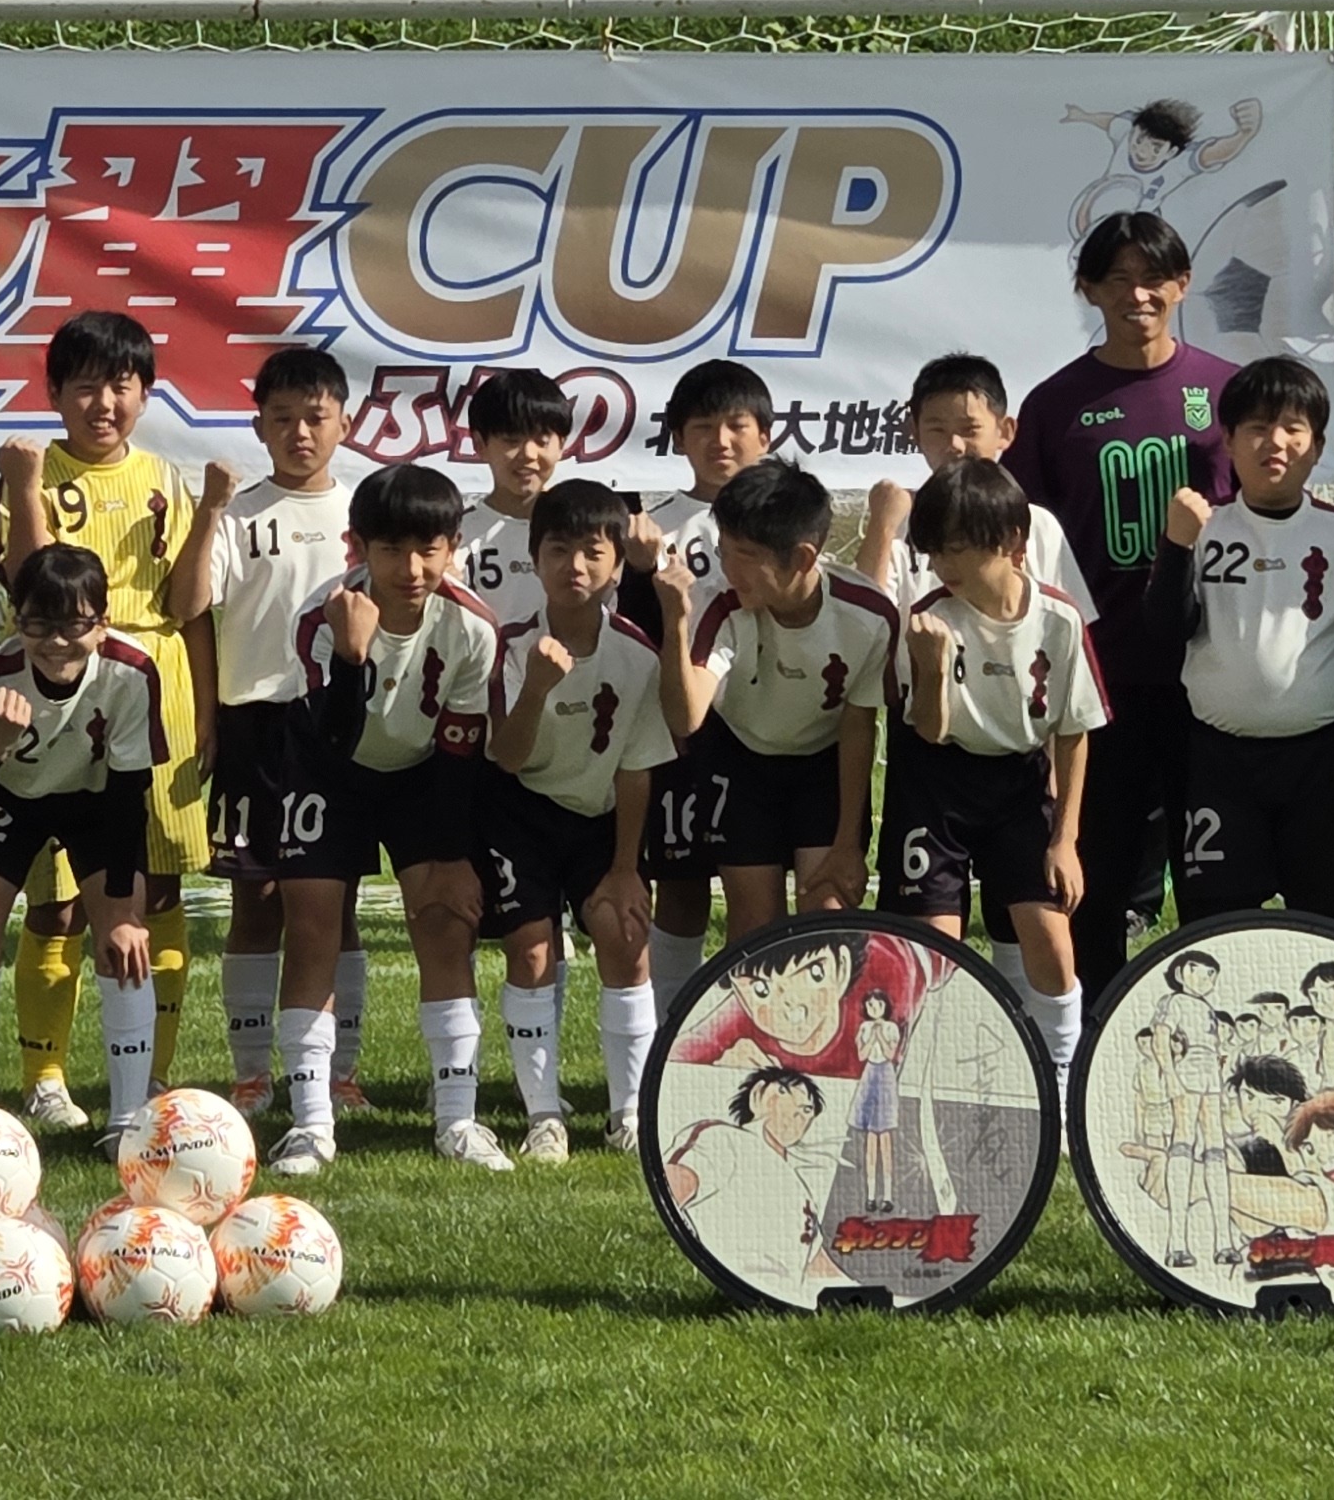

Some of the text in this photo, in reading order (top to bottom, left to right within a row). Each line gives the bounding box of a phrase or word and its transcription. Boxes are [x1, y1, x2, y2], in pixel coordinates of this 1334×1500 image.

[344, 365, 637, 464] ふの
[247, 518, 281, 560] 11
[1201, 540, 1250, 585] 22
[212, 792, 250, 848] 11
[279, 791, 327, 844] 10
[903, 826, 930, 881] 6
